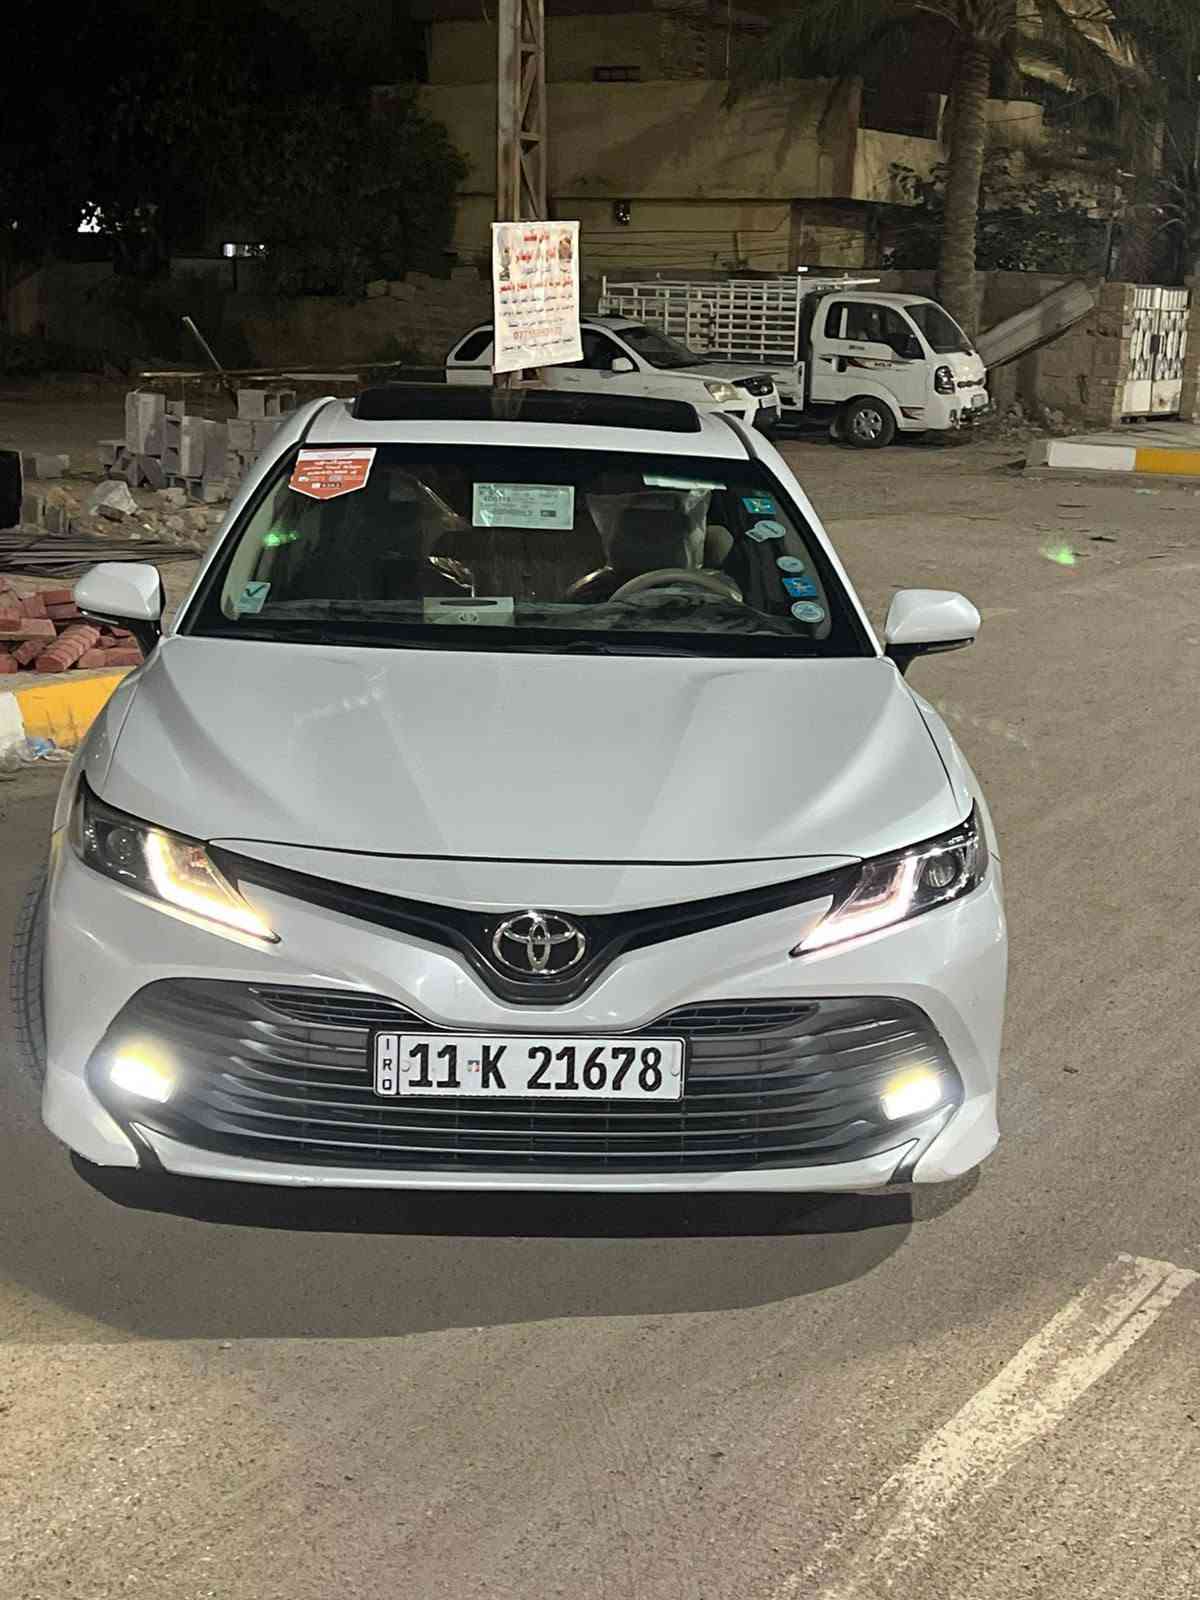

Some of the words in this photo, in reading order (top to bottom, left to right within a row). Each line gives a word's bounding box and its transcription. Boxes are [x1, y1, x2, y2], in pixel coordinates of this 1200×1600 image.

[408, 1043, 461, 1088] 11
[481, 1045, 507, 1089] K
[527, 1046, 662, 1092] 21678
